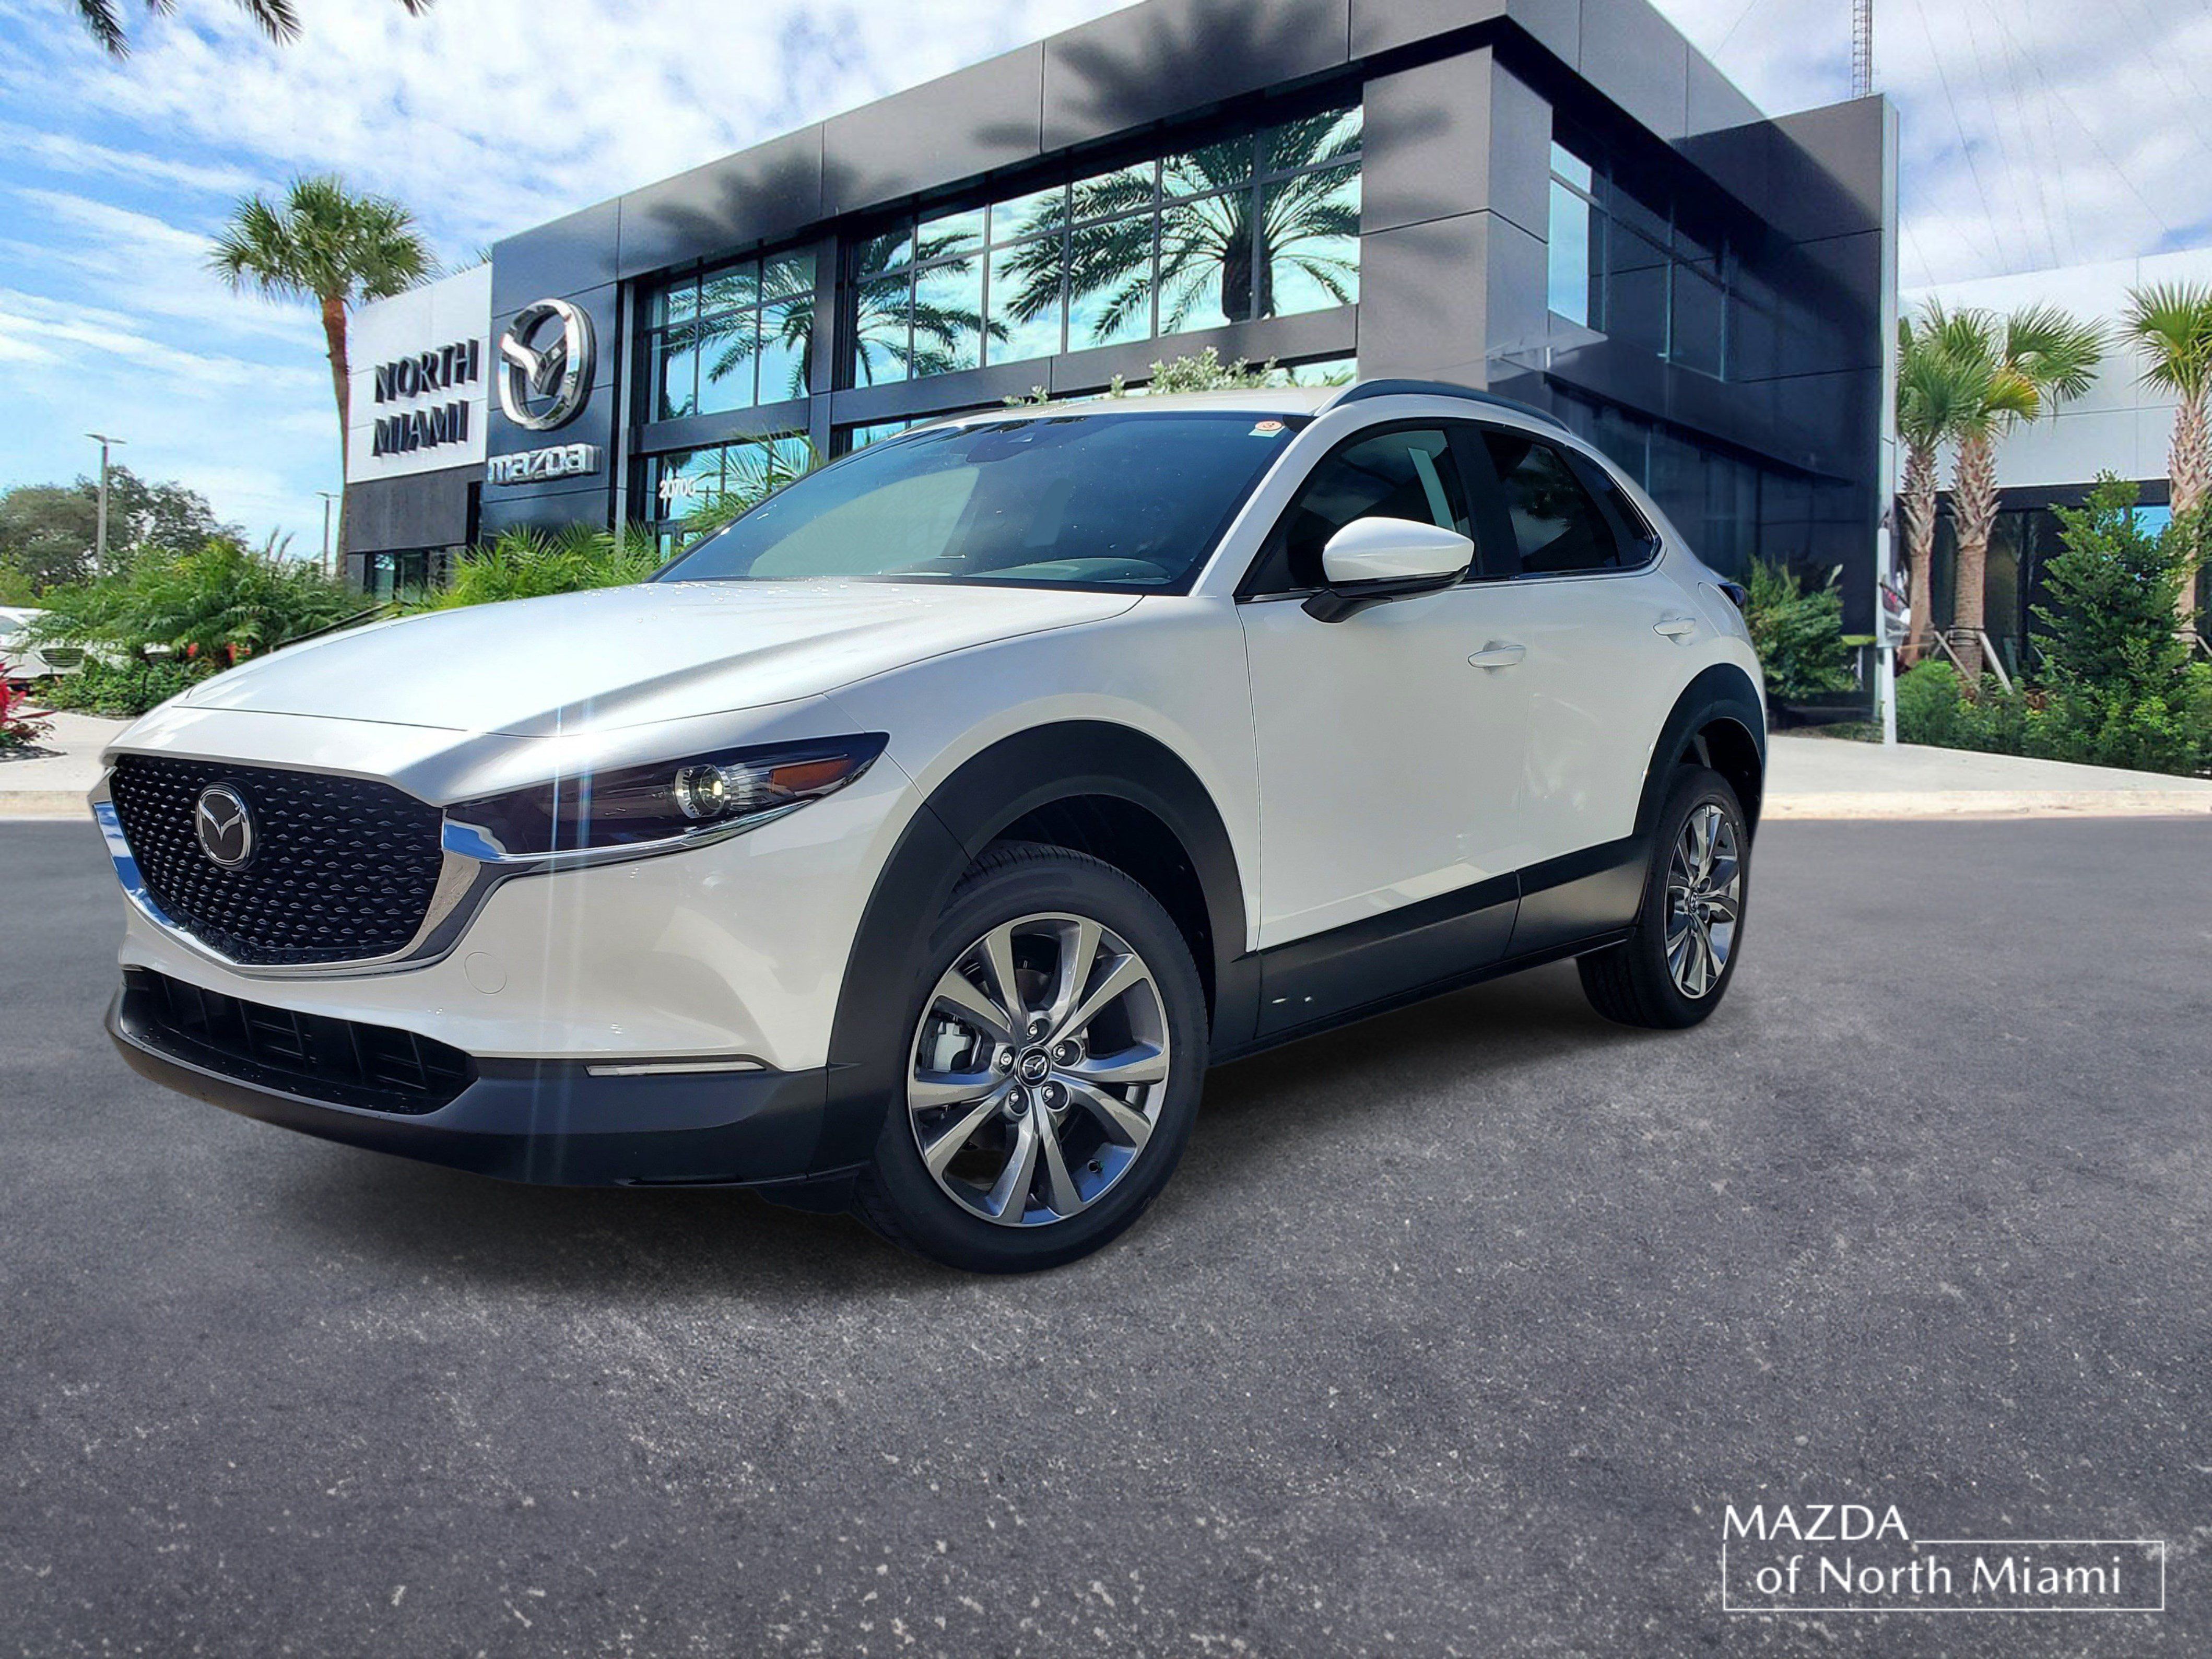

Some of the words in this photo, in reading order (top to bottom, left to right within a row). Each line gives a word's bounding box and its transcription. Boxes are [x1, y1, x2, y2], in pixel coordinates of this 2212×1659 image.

[373, 338, 479, 404] NORTH
[371, 399, 469, 458] MIAMI
[488, 443, 596, 484] mazda
